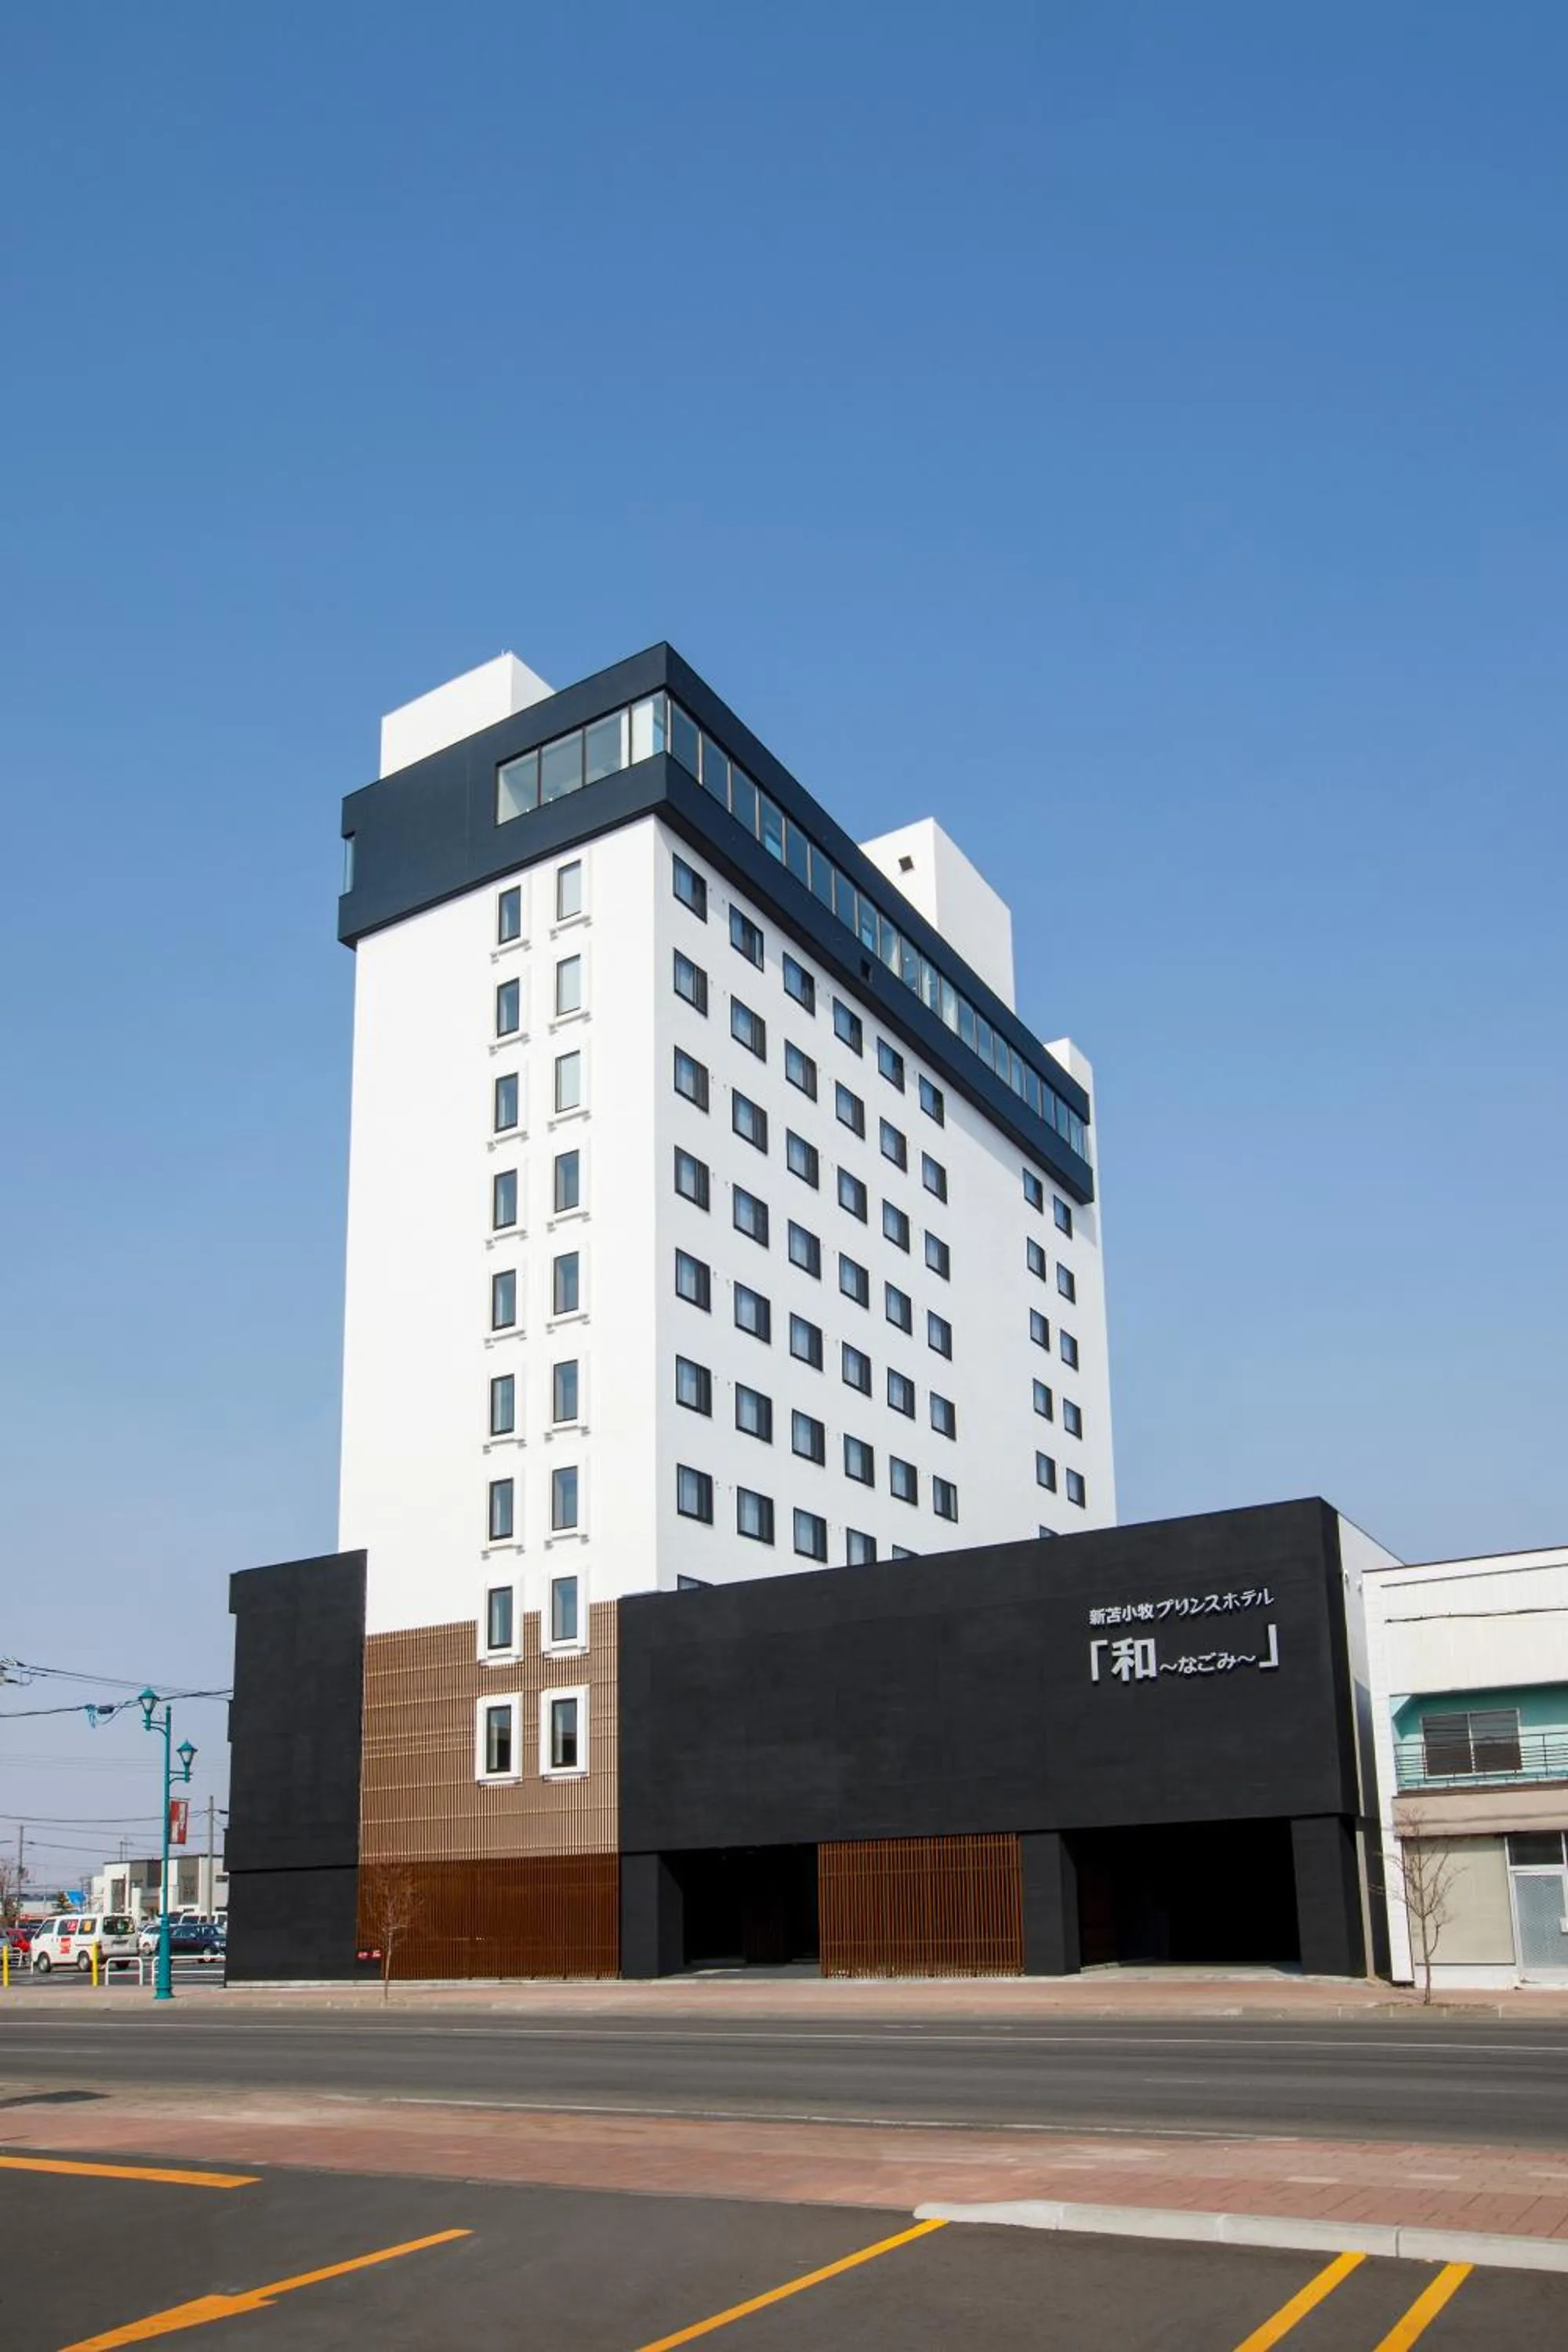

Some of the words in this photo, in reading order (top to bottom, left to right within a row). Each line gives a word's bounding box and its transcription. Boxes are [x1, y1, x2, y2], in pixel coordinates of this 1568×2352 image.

[1089, 1588, 1274, 1625] 新苫小牧プリンスホテル
